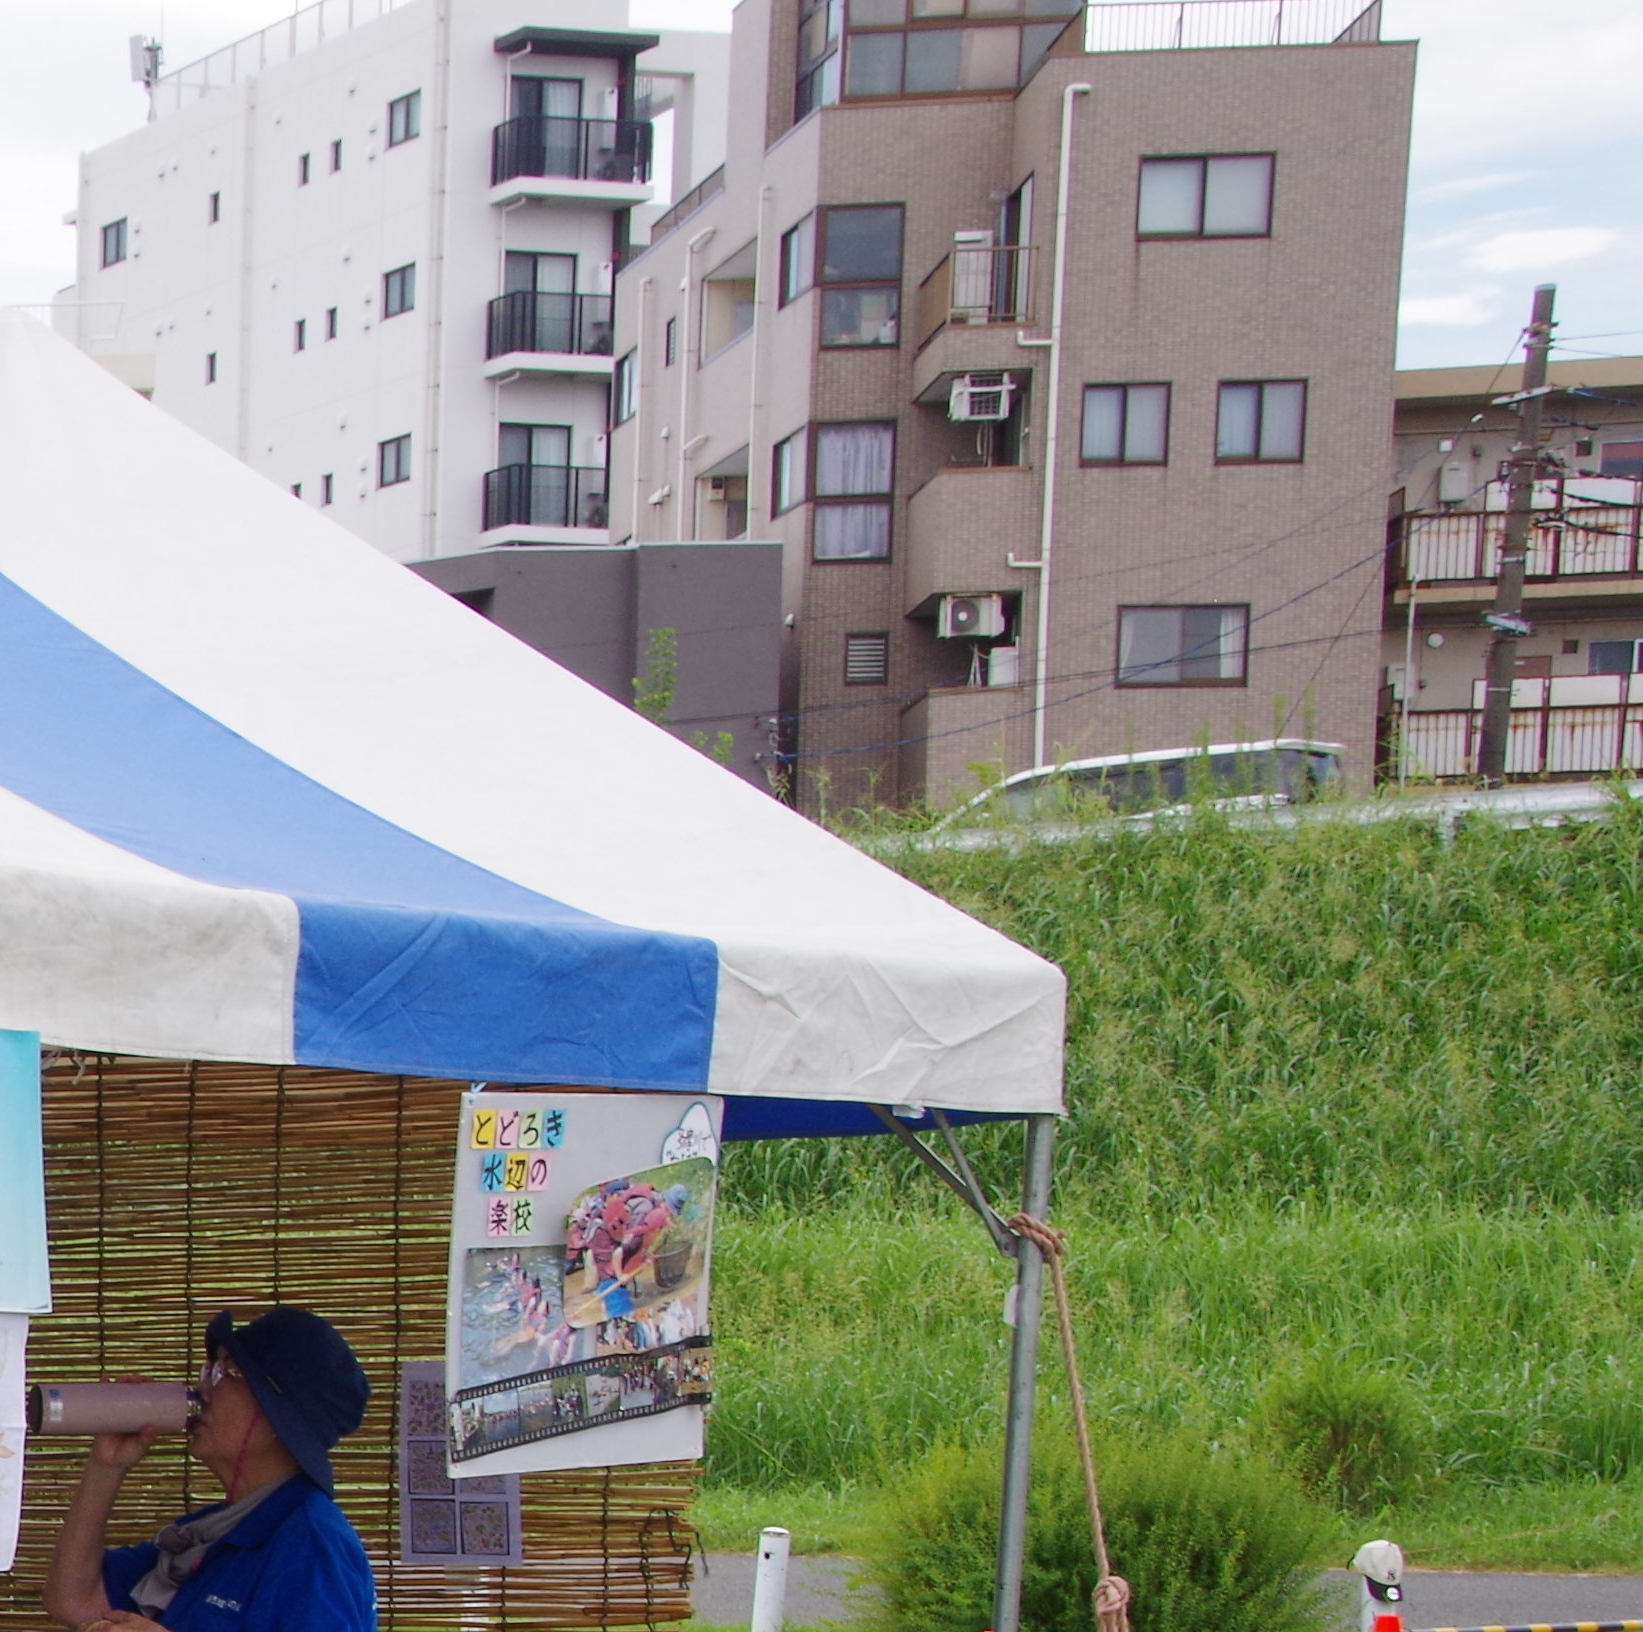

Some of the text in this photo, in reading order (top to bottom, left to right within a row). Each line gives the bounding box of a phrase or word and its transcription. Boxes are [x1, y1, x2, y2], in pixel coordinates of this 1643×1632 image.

[473, 1112, 565, 1148] とどろき
[482, 1156, 550, 1192] 水辺の
[489, 1200, 534, 1234] 楽校
